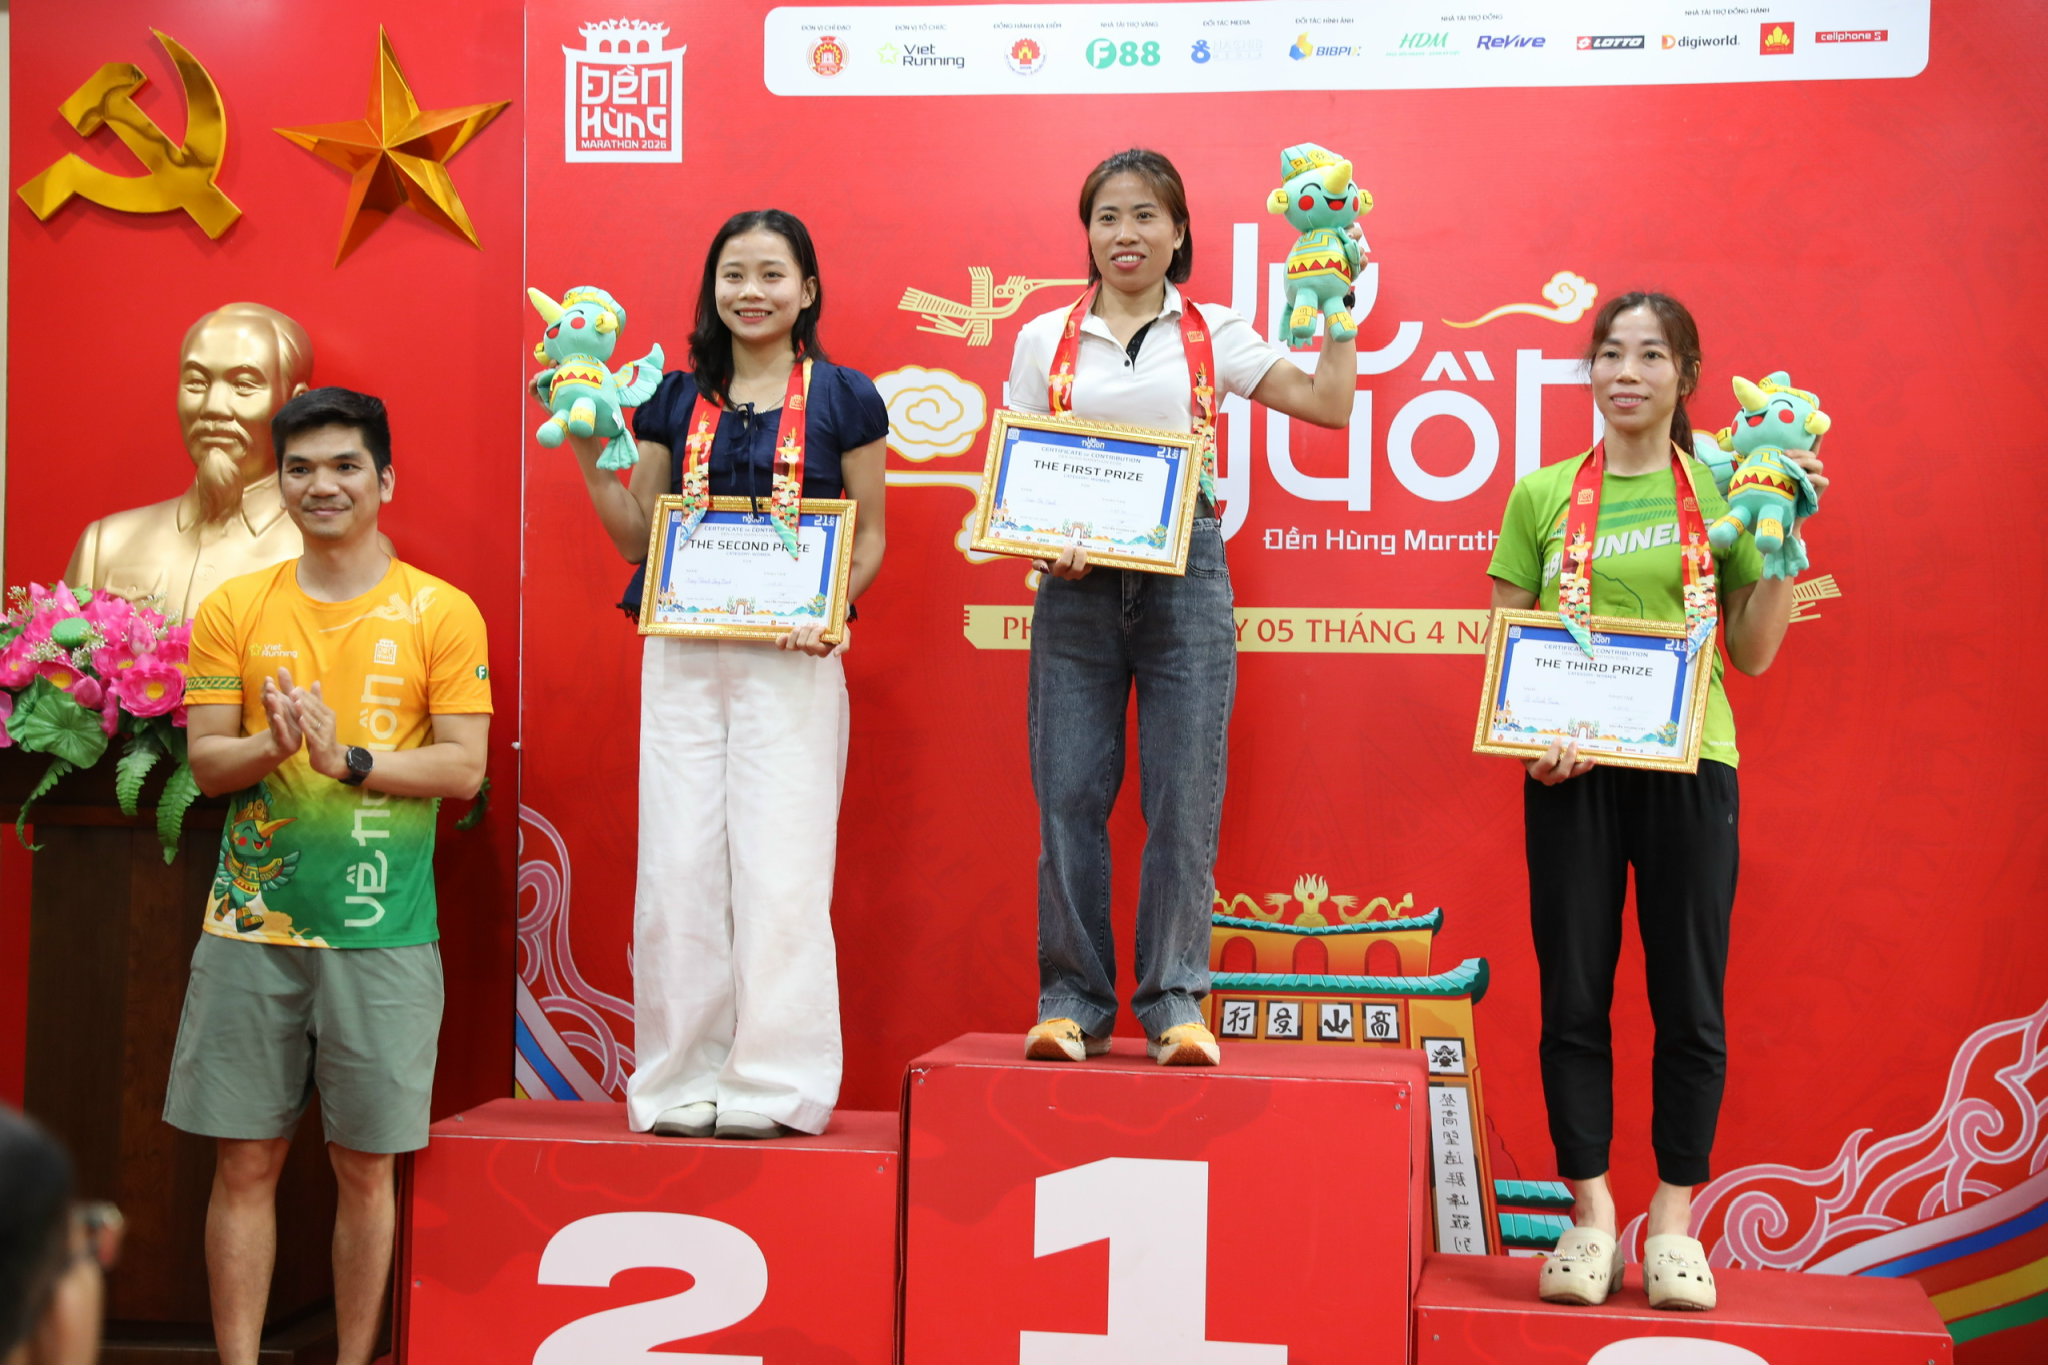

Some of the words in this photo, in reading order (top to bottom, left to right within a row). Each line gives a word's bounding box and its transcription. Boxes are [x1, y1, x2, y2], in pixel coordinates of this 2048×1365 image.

[904, 43, 936, 55] Viet
[903, 56, 965, 69] Running
[582, 140, 639, 150] MARATHON
[642, 140, 667, 150] 2026
[1041, 446, 1082, 456] CERTIFICATE
[1091, 452, 1142, 464] CONTRIBUTION
[1034, 460, 1060, 471] THE
[1063, 464, 1102, 476] FIRST
[1104, 469, 1144, 482] PRIZE
[690, 539, 714, 550] THE
[718, 540, 769, 552] SECOND
[1263, 526, 1317, 550] Đền
[1326, 529, 1396, 555] Hùng
[1404, 529, 1501, 550] Marath
[1257, 618, 1294, 642] 05
[1306, 612, 1416, 644] THÁNG
[1426, 621, 1445, 643] 4
[262, 650, 298, 659] Running
[1544, 643, 1579, 652] CERTIFICA
[1596, 648, 1648, 658] CONTRIBUTION
[1534, 657, 1562, 669] THE
[1566, 660, 1608, 672] THIRD
[1612, 664, 1654, 677] PRIZE
[1018, 1158, 1288, 1365] 1
[532, 1211, 770, 1365] 2
